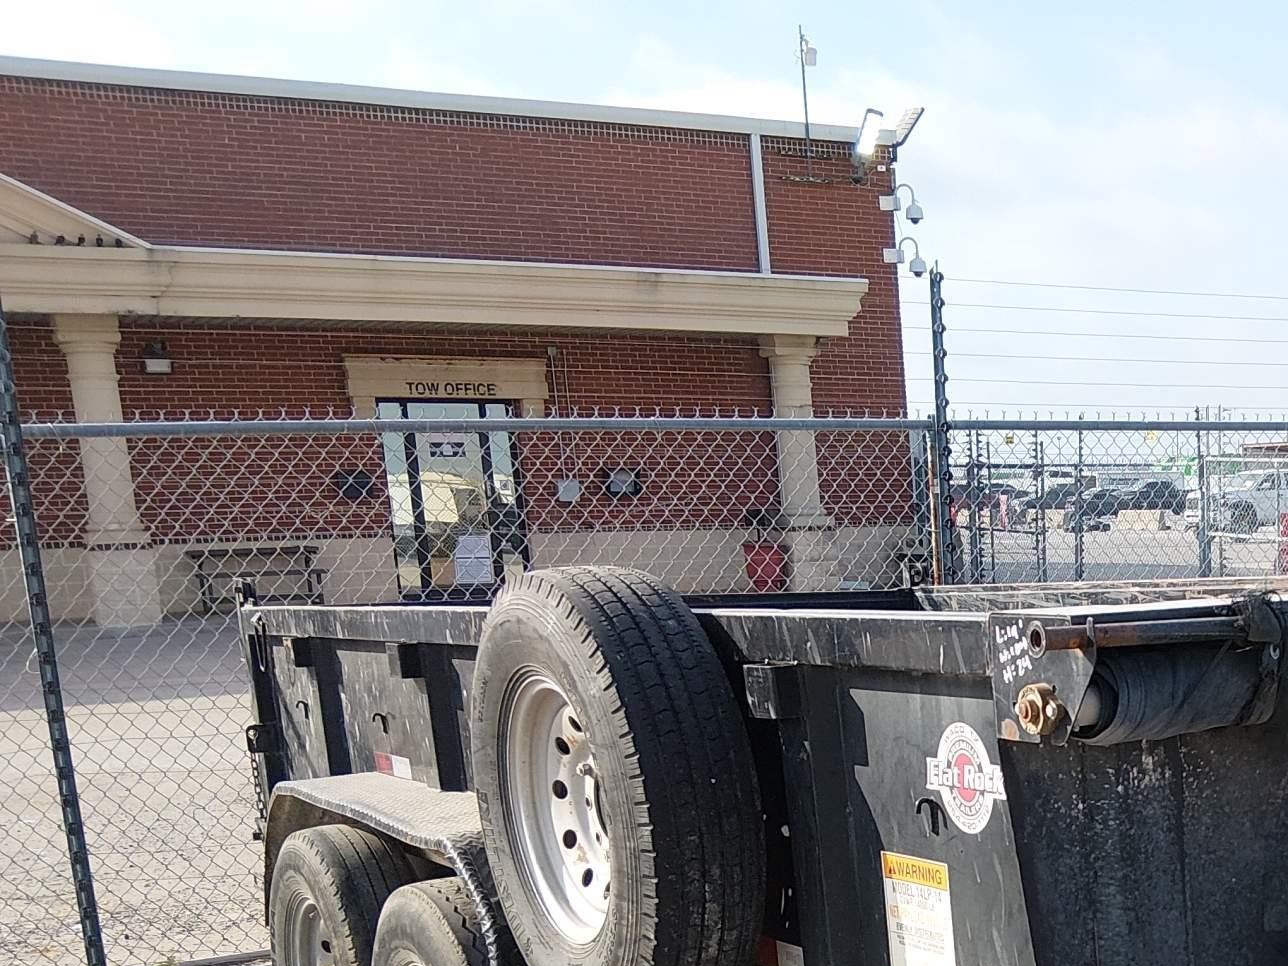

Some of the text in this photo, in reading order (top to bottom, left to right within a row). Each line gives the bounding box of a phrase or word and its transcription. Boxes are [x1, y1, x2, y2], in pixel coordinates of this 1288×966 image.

[405, 382, 497, 396] TOW OFFICE
[895, 864, 943, 886] WARNING
